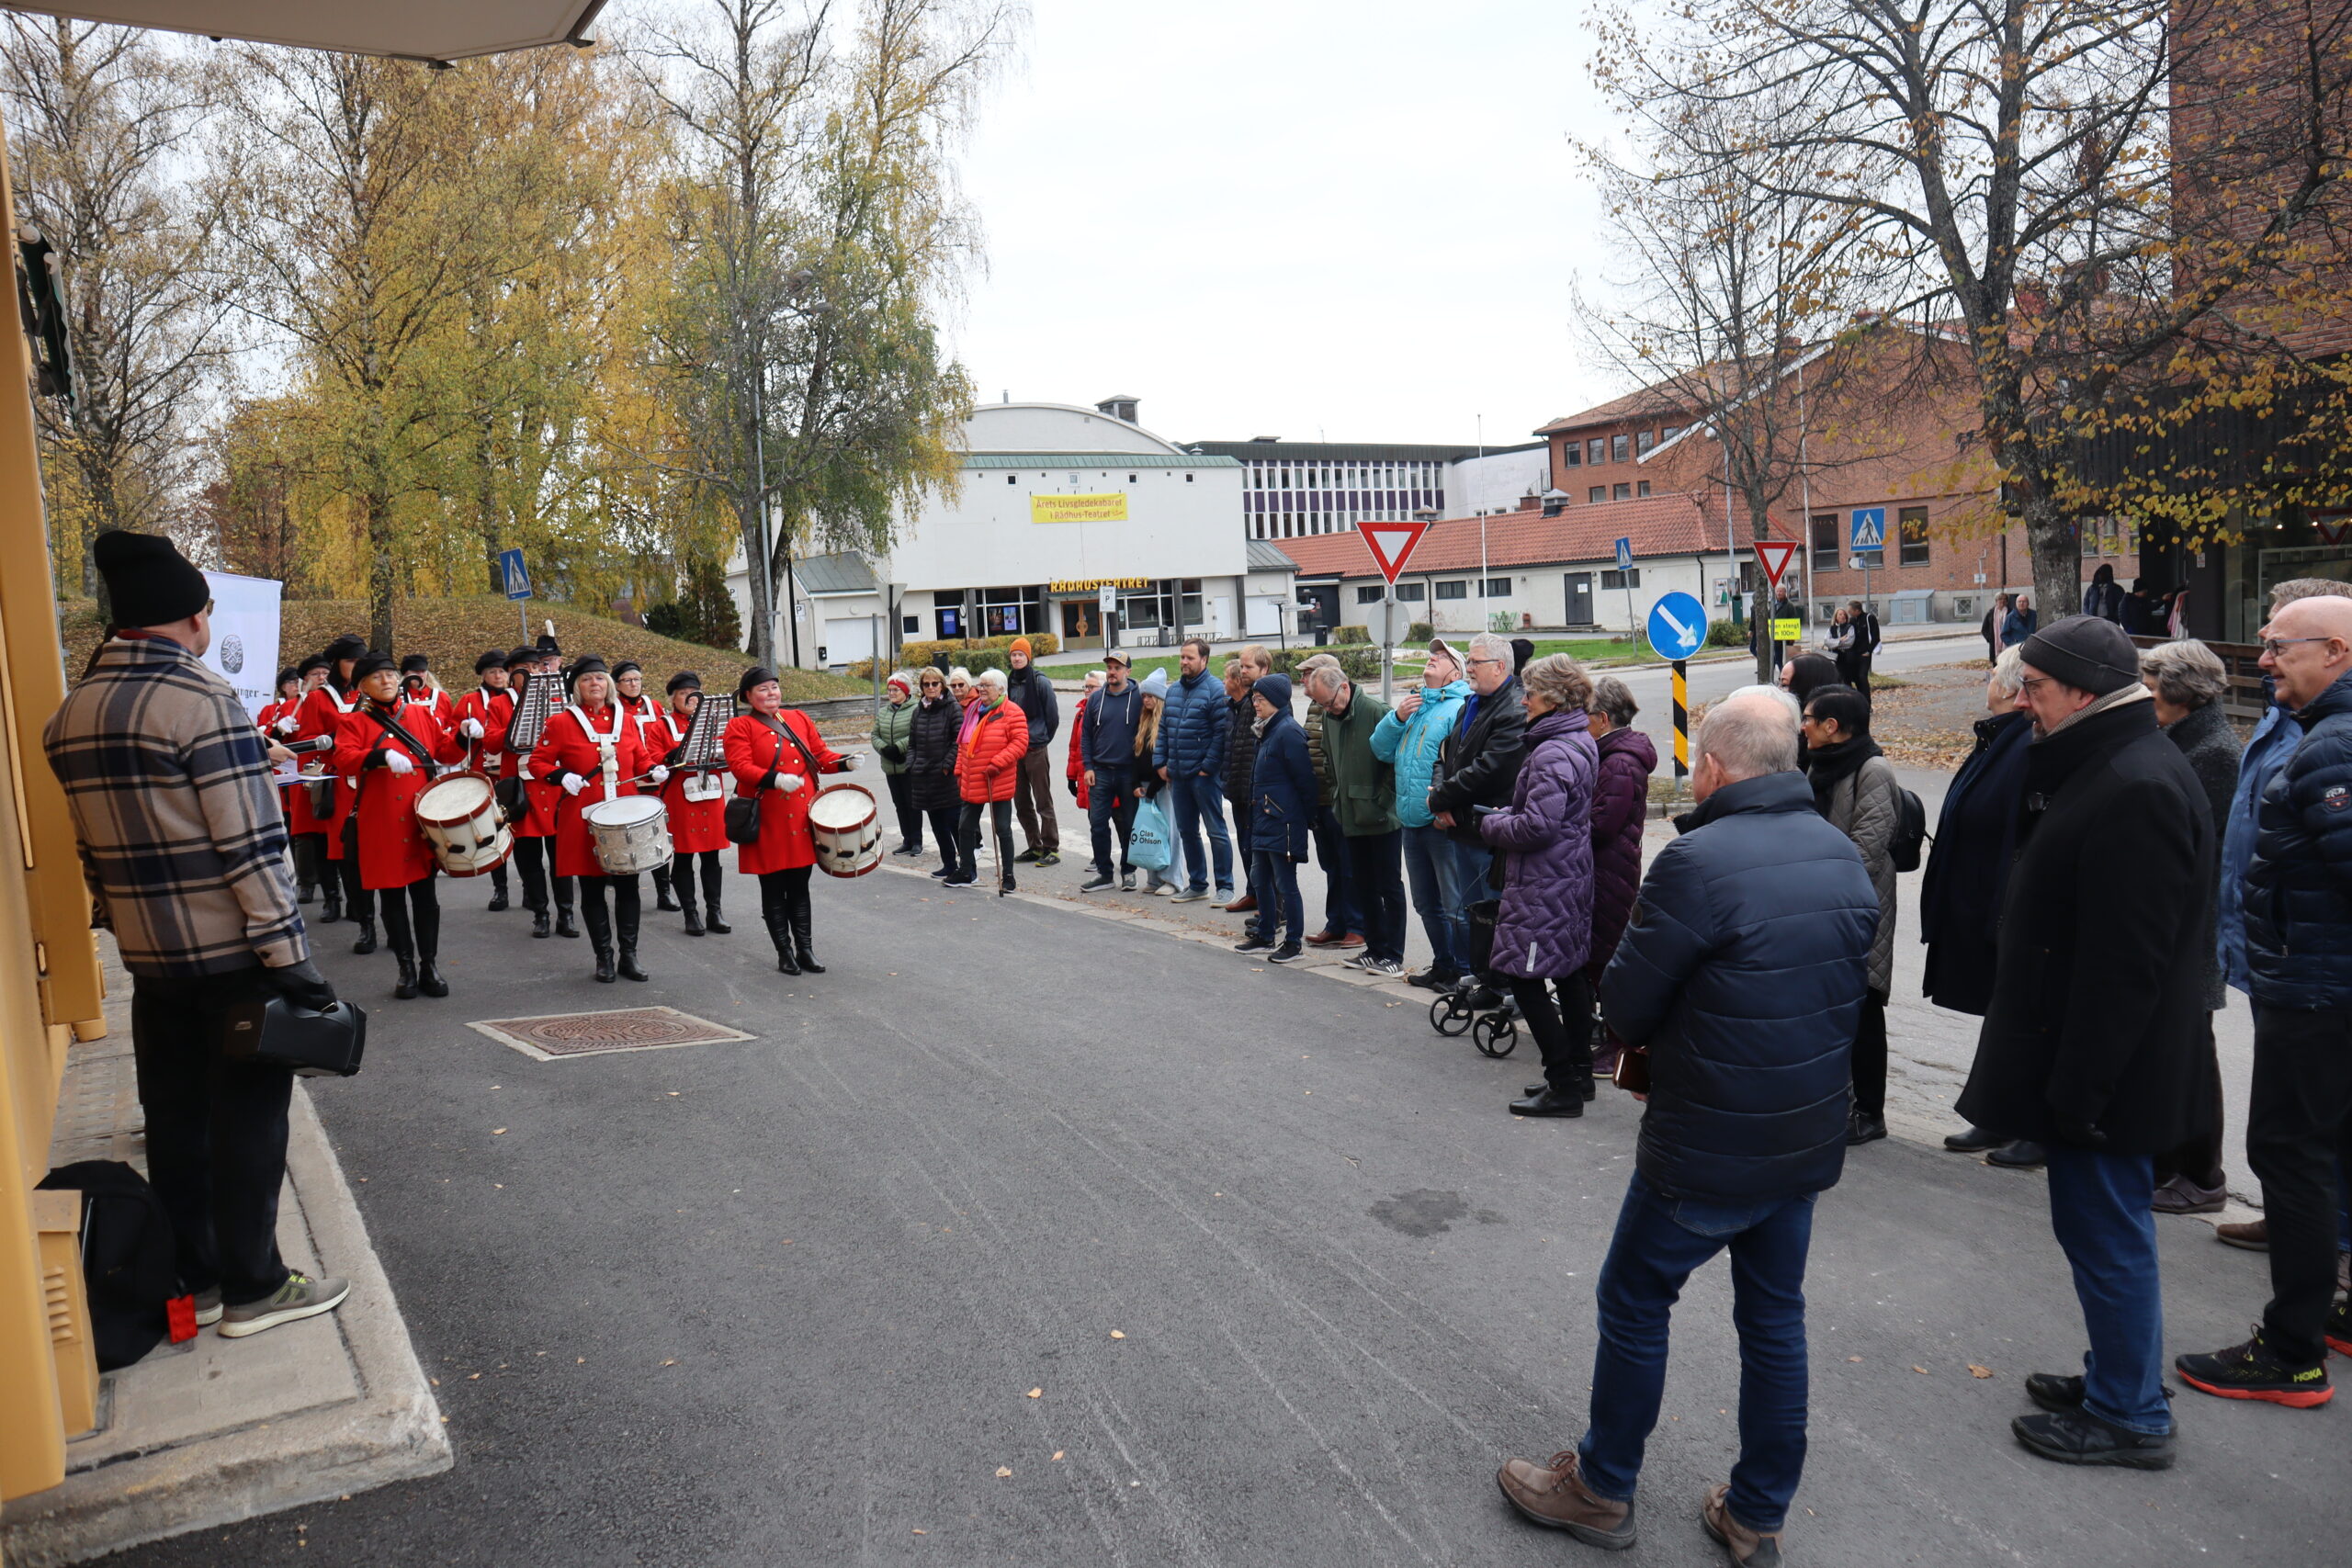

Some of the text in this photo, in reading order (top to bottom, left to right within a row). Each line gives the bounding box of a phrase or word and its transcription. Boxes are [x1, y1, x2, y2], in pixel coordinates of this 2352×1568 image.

[1036, 498, 1122, 509] Årets Livsgledekabaret
[1055, 510, 1111, 519] Rådhus-Teatret
[1050, 577, 1148, 592] RÅDHUSTEATRET
[729, 588, 735, 596] P
[796, 606, 802, 615] P
[2293, 1367, 2323, 1382] HOKA
